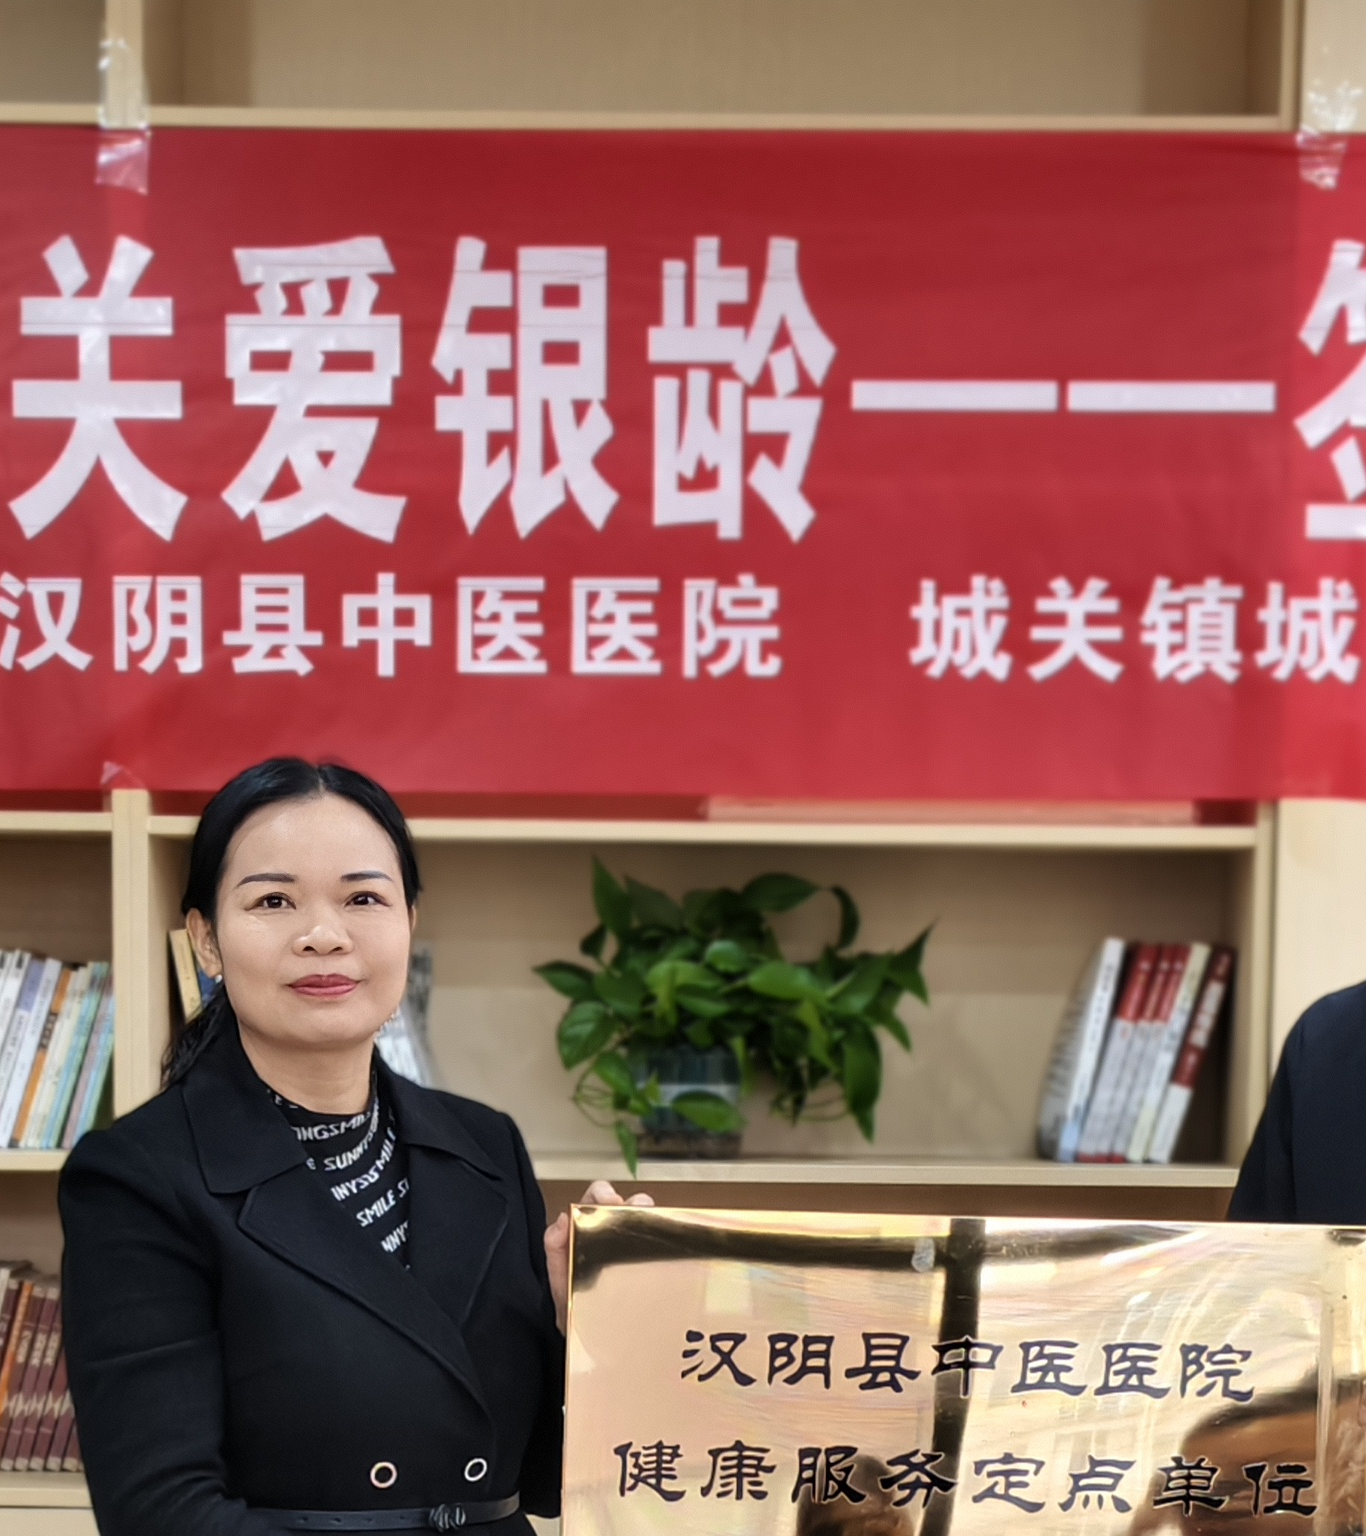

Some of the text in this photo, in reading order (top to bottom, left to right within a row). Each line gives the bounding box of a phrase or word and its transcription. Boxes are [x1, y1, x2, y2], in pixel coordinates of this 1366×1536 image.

[356, 1189, 396, 1227] SMILE
[680, 1329, 1255, 1402] 汉阴县中医医院
[612, 1439, 1320, 1517] 健康服务定点单位
